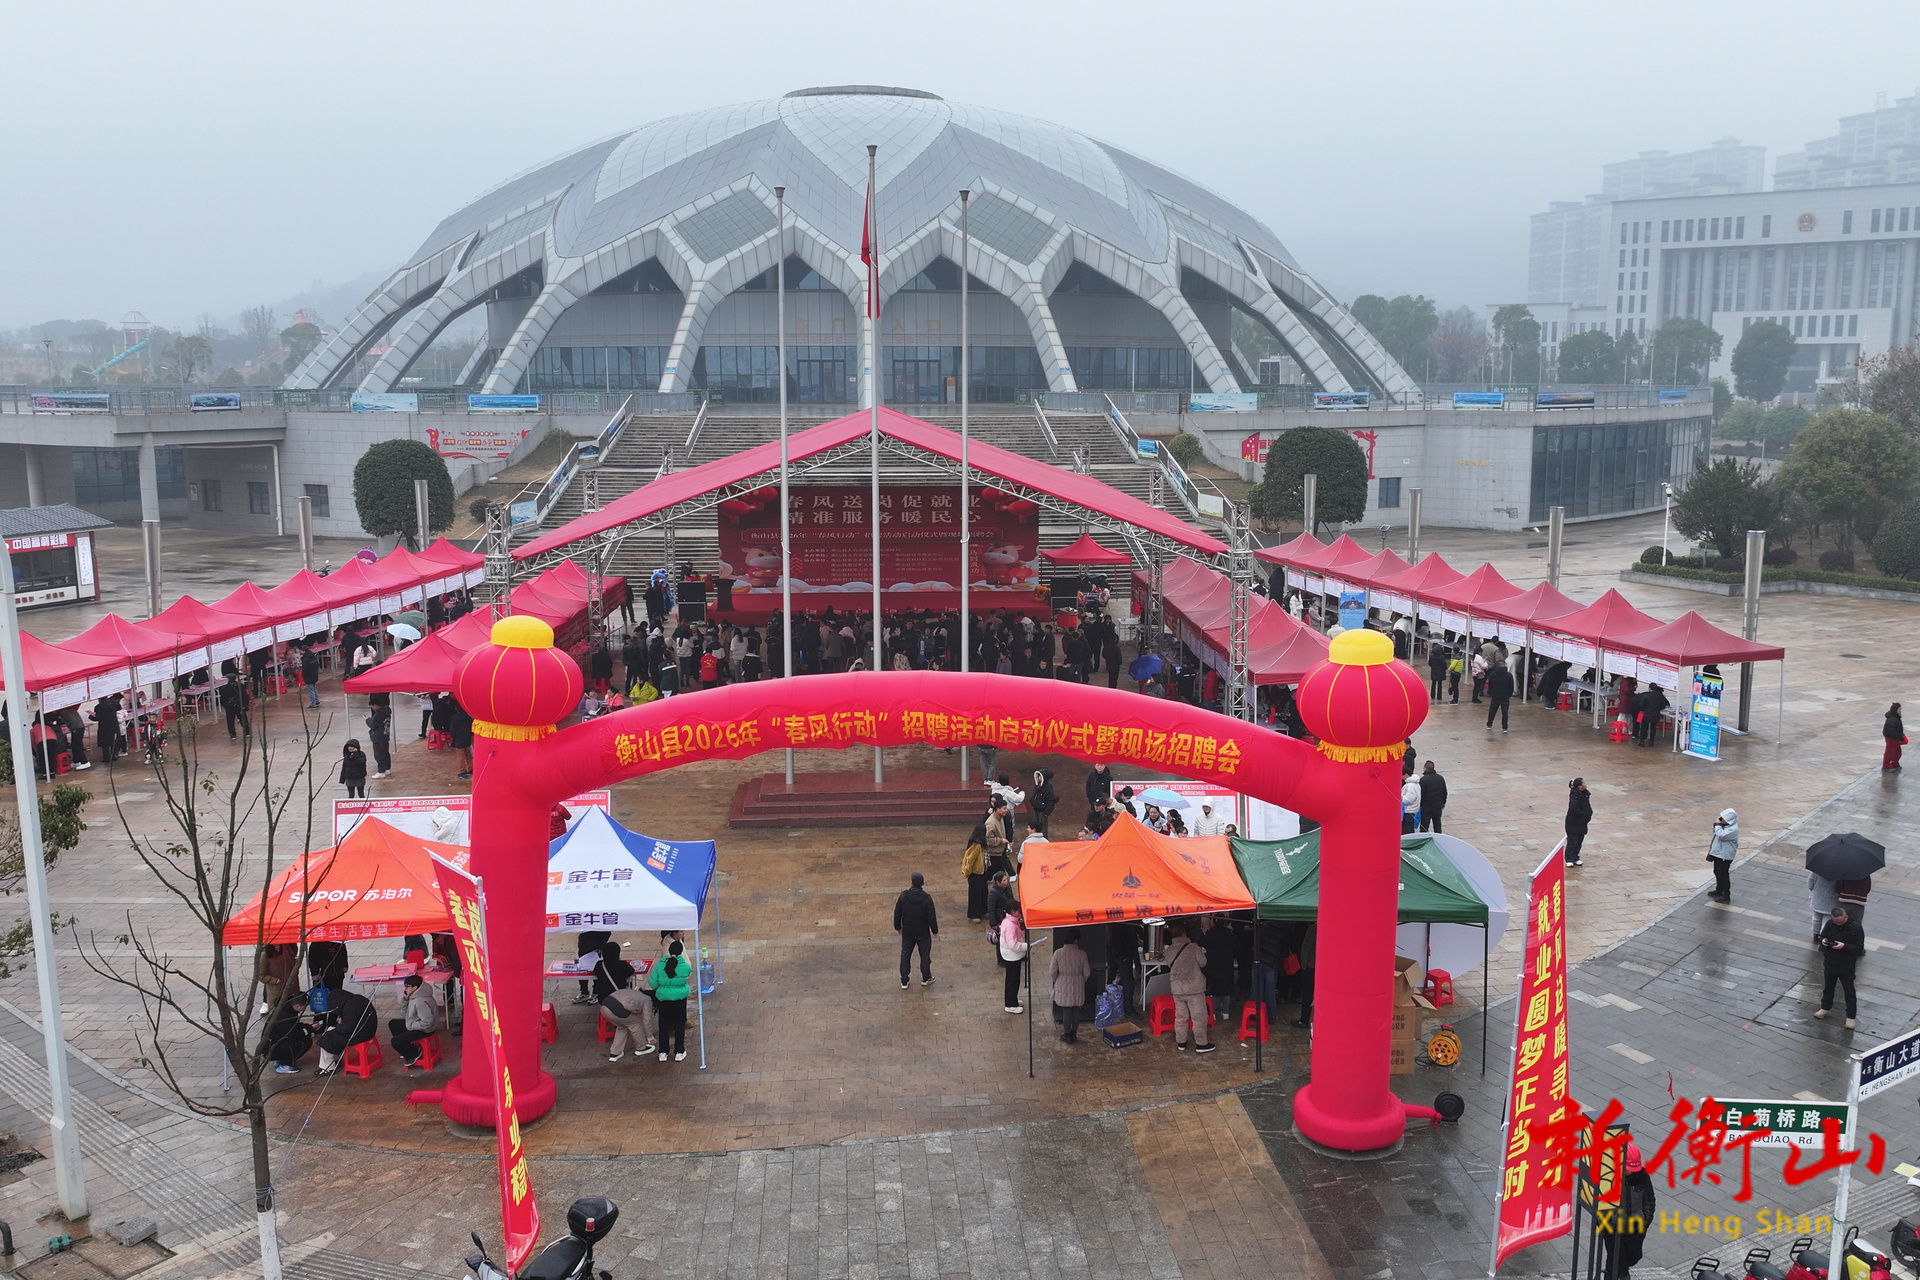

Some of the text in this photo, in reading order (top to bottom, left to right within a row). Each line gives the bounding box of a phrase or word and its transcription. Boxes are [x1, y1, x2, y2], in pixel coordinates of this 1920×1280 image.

[567, 867, 634, 884] 金牛管
[363, 887, 414, 901] 苏泊尔
[565, 912, 619, 926] 金牛管
[1503, 894, 1551, 1202] 就业圆梦正当时
[1873, 1039, 1920, 1076] 衡山大道
[1872, 1071, 1904, 1092] HENGSHAN
[1726, 1107, 1822, 1130] 白菊桥路
[1798, 1136, 1816, 1146] Rd.
